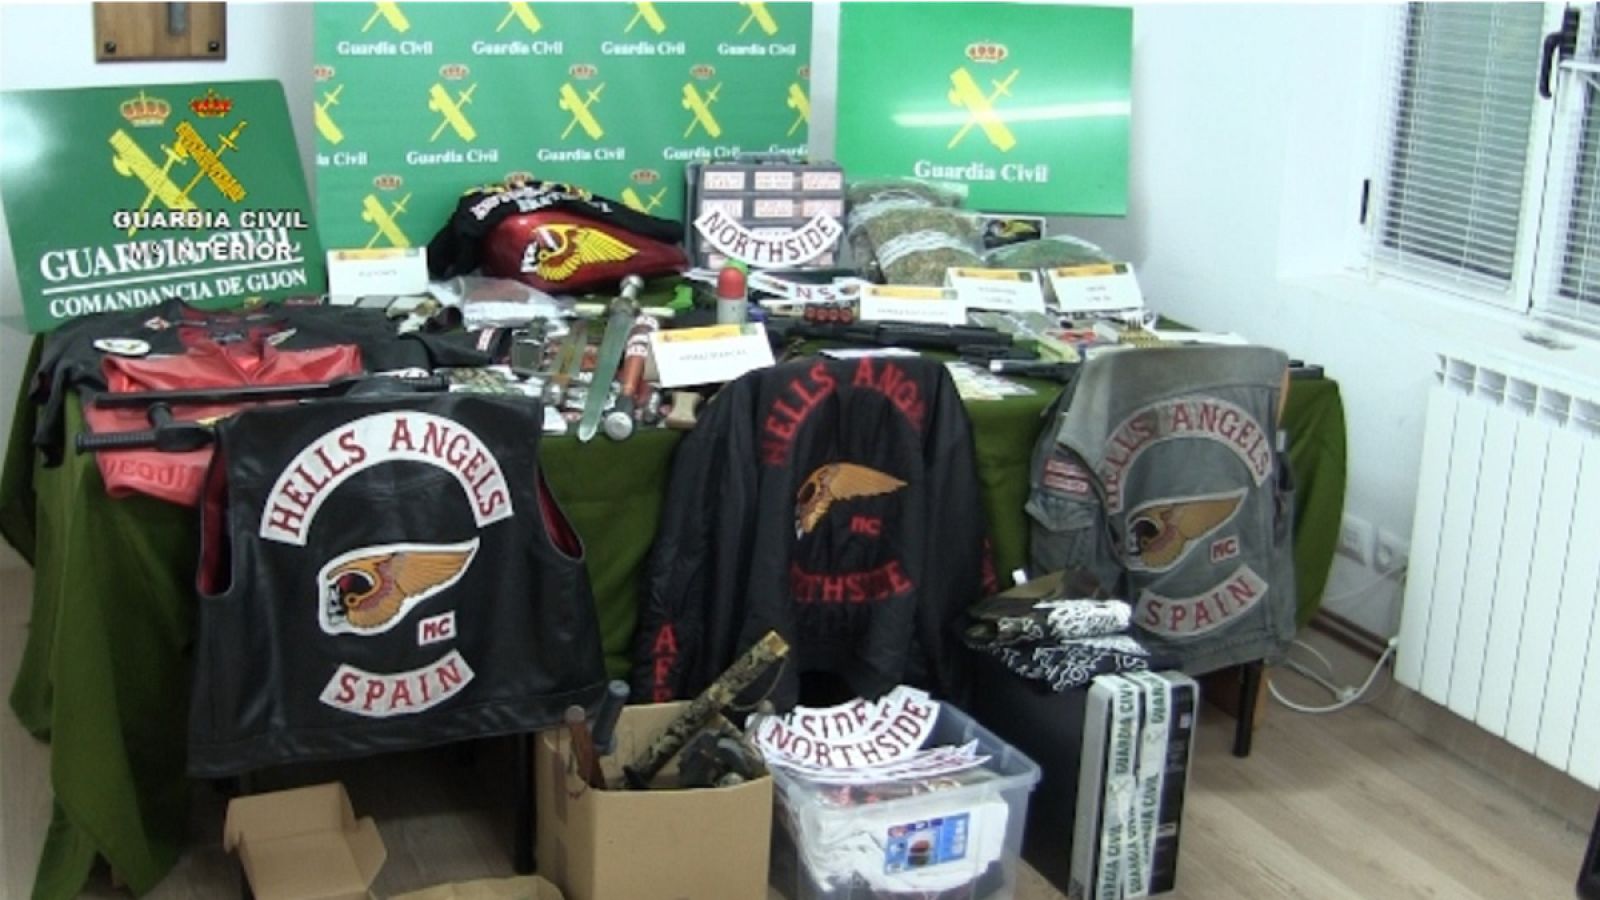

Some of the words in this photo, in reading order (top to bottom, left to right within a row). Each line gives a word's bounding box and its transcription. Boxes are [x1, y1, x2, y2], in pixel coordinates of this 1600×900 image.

[337, 41, 397, 56] Guardia
[400, 41, 433, 56] Civil
[472, 41, 530, 55] Guardia
[532, 41, 563, 55] Civil
[601, 41, 655, 56] Guardia
[657, 41, 686, 56] Civil
[717, 43, 766, 56] Guardia
[768, 43, 796, 56] Civil
[333, 151, 368, 166] Civil
[406, 150, 464, 165] Guardia
[466, 149, 498, 163] Civil
[537, 148, 592, 161] Guardia
[594, 147, 625, 160] Civil
[663, 146, 711, 160] Guardia
[913, 159, 996, 181] Guardia
[1000, 163, 1048, 183] Civil
[702, 210, 838, 263] NORTHSIDE
[49, 280, 214, 319] COMANDANCIA
[215, 276, 244, 298] DE
[246, 268, 309, 292] GIJON
[1170, 402, 1271, 477] ANGELS
[268, 430, 368, 537] HELLS
[389, 417, 506, 518] ANGELS
[1144, 576, 1256, 632] SPAIN
[422, 617, 451, 642] MC
[336, 657, 462, 712] SPAIN
[766, 698, 933, 767] NORTHSIDE
